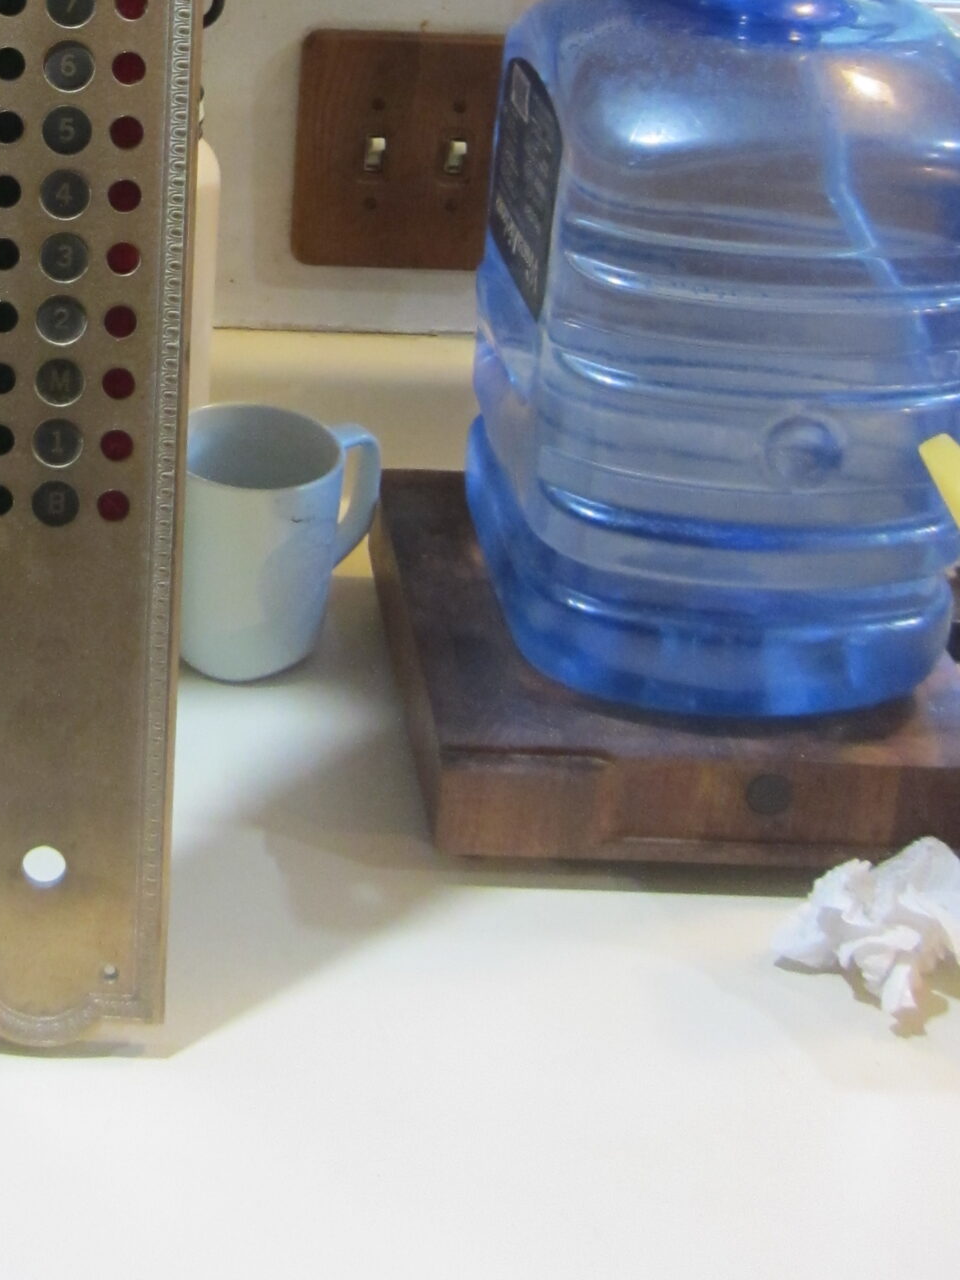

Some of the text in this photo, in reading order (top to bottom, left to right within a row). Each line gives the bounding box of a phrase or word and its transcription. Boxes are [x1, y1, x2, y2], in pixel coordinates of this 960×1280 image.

[60, 53, 77, 77] 6
[58, 117, 76, 141] 5
[55, 182, 73, 207] 4
[56, 244, 74, 267] 3
[53, 307, 71, 330] 2
[50, 371, 71, 393] M
[51, 430, 64, 453] 1
